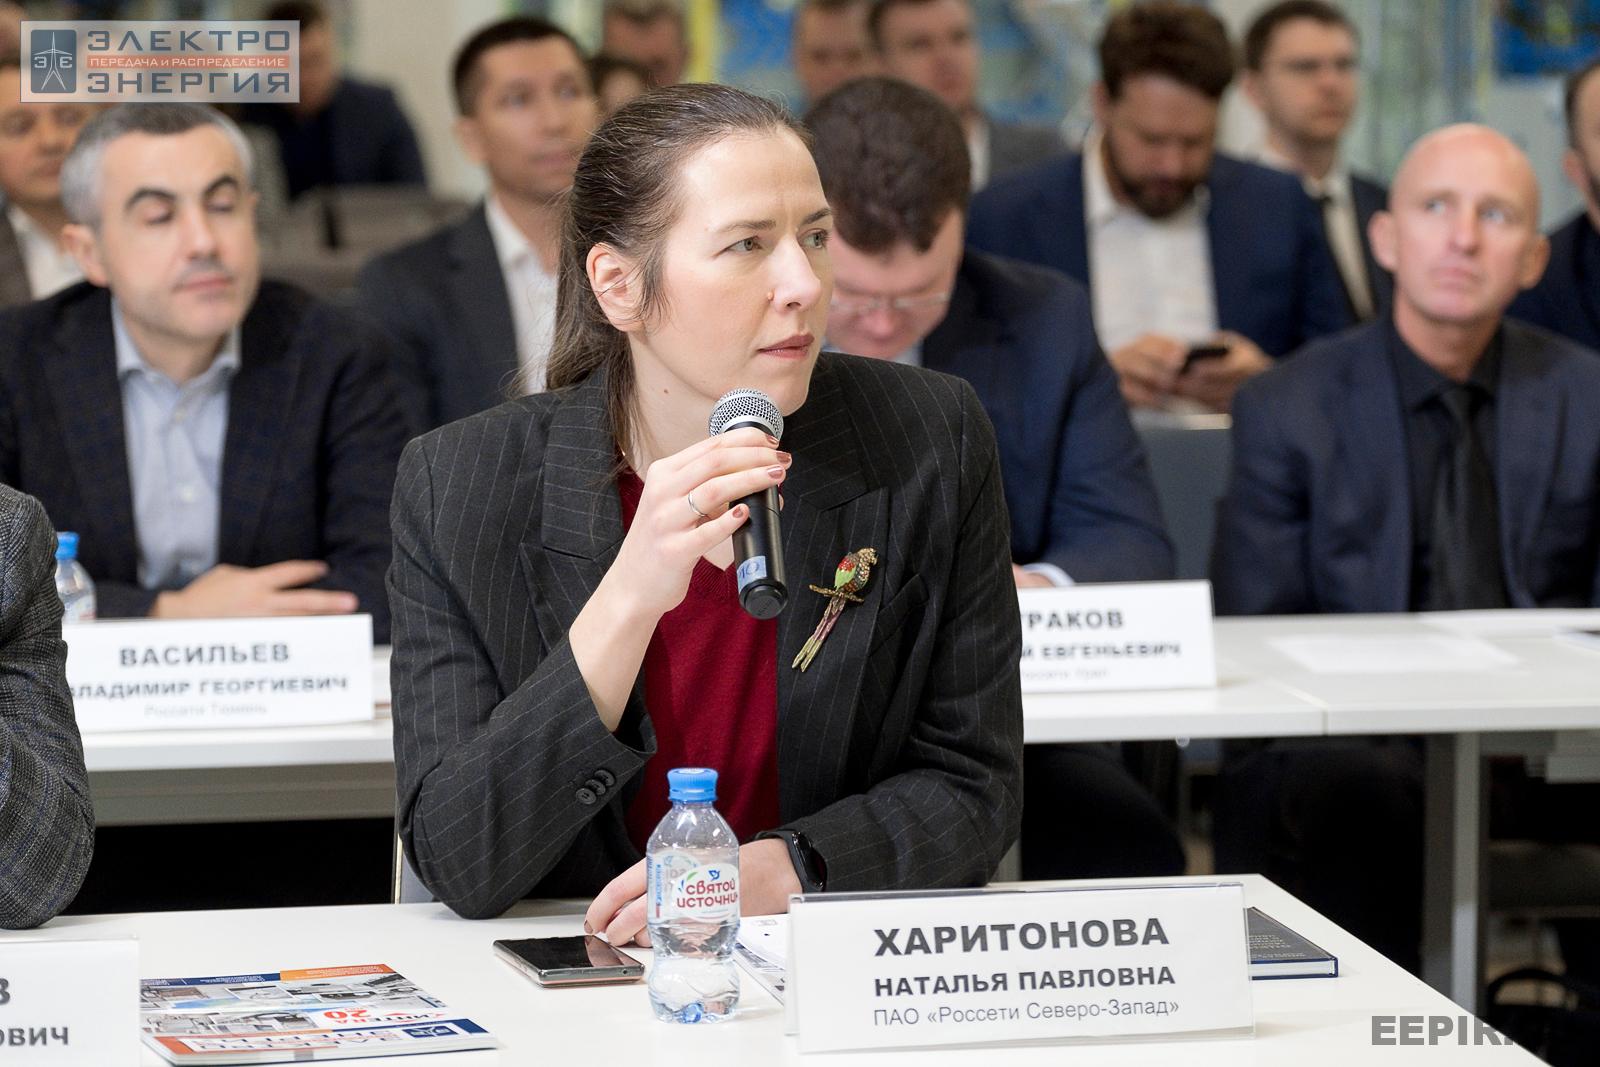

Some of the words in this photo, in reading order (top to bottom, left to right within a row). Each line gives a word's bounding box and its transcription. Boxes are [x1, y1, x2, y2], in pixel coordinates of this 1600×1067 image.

[1020, 610, 1124, 630] РАКОВ
[119, 643, 290, 668] ВАСИЛЬЕВ
[199, 676, 348, 696] ГЕОРГИЕВИЧ
[874, 917, 1170, 957] ХАРИТОНОВА
[874, 973, 1008, 997] НАТАЛЬЯ
[1018, 966, 1176, 991] ПАВЛОВНА
[873, 1007, 920, 1026] ПАО
[927, 1005, 1020, 1024] «Россети
[1026, 999, 1180, 1021] Северо-Запад»
